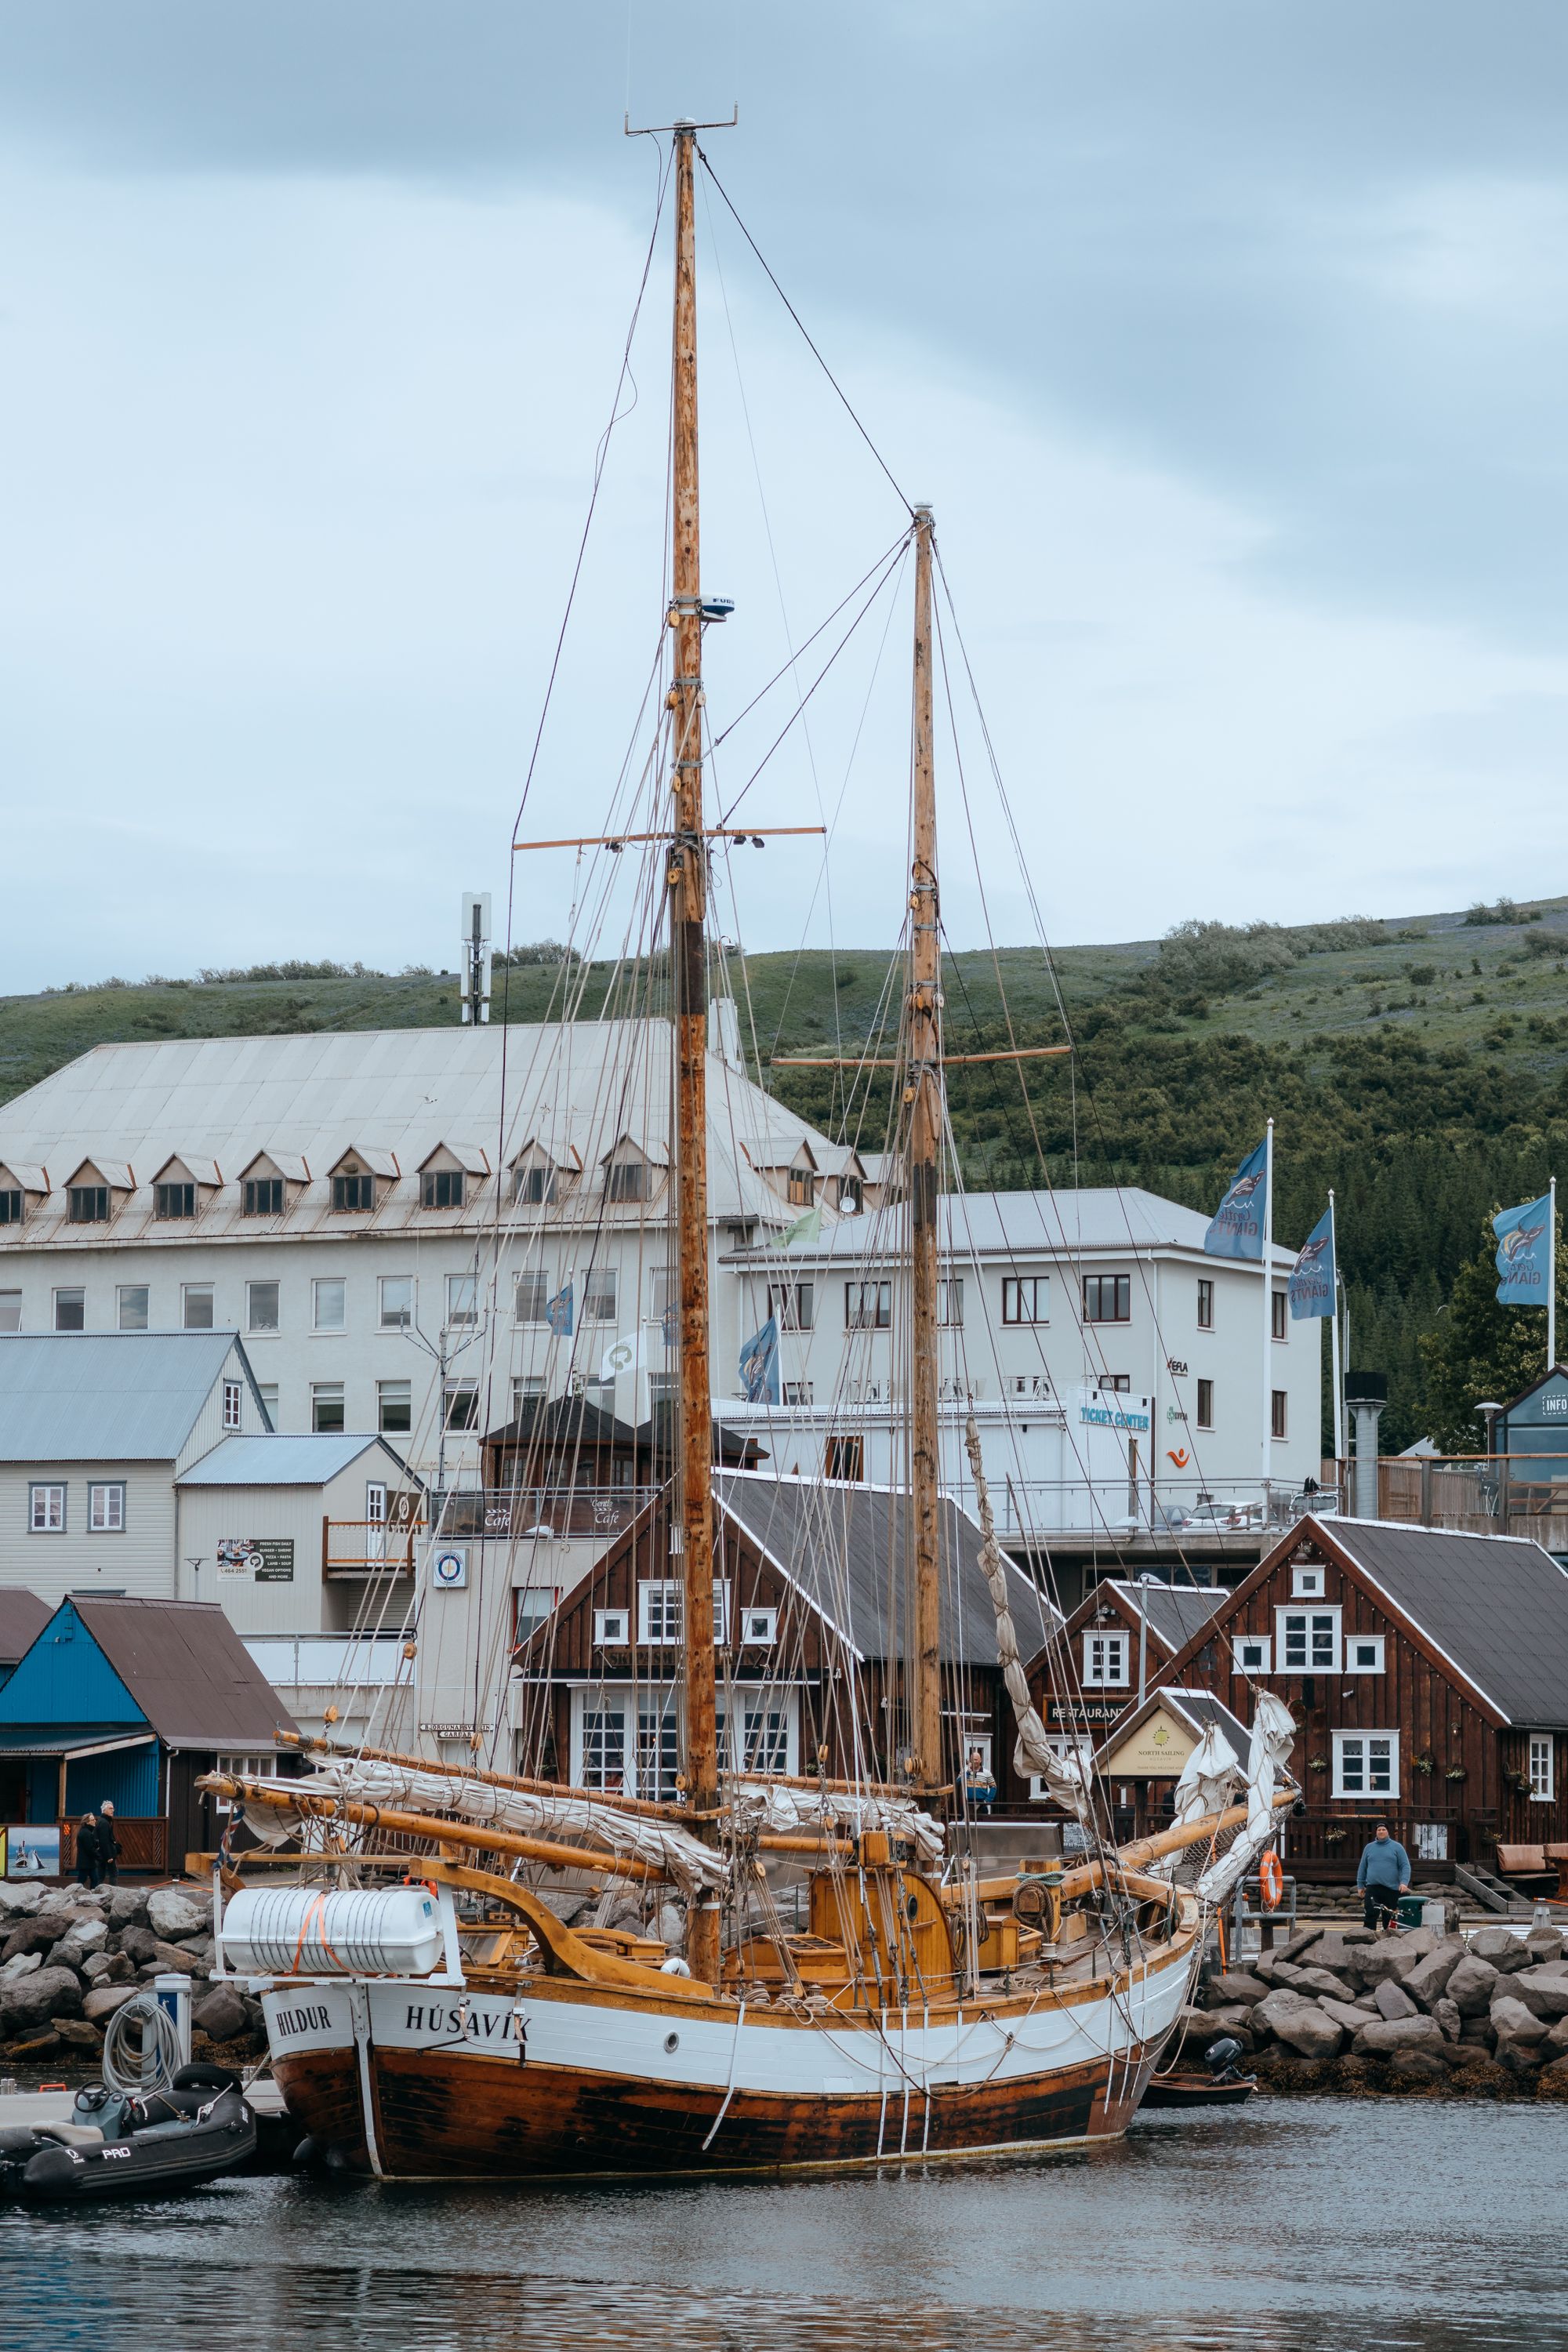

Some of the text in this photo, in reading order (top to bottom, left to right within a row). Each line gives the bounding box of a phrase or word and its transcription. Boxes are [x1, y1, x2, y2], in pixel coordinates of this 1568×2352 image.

[1171, 1360, 1188, 1373] EFLA
[1546, 1399, 1567, 1411] INFO
[1081, 1406, 1149, 1430] TICKET CENTER
[592, 1499, 613, 1508] Gentle
[276, 2005, 332, 2037] HILDUR
[405, 1995, 532, 2042] HÚSAVÍK
[101, 2147, 132, 2160] PRO
